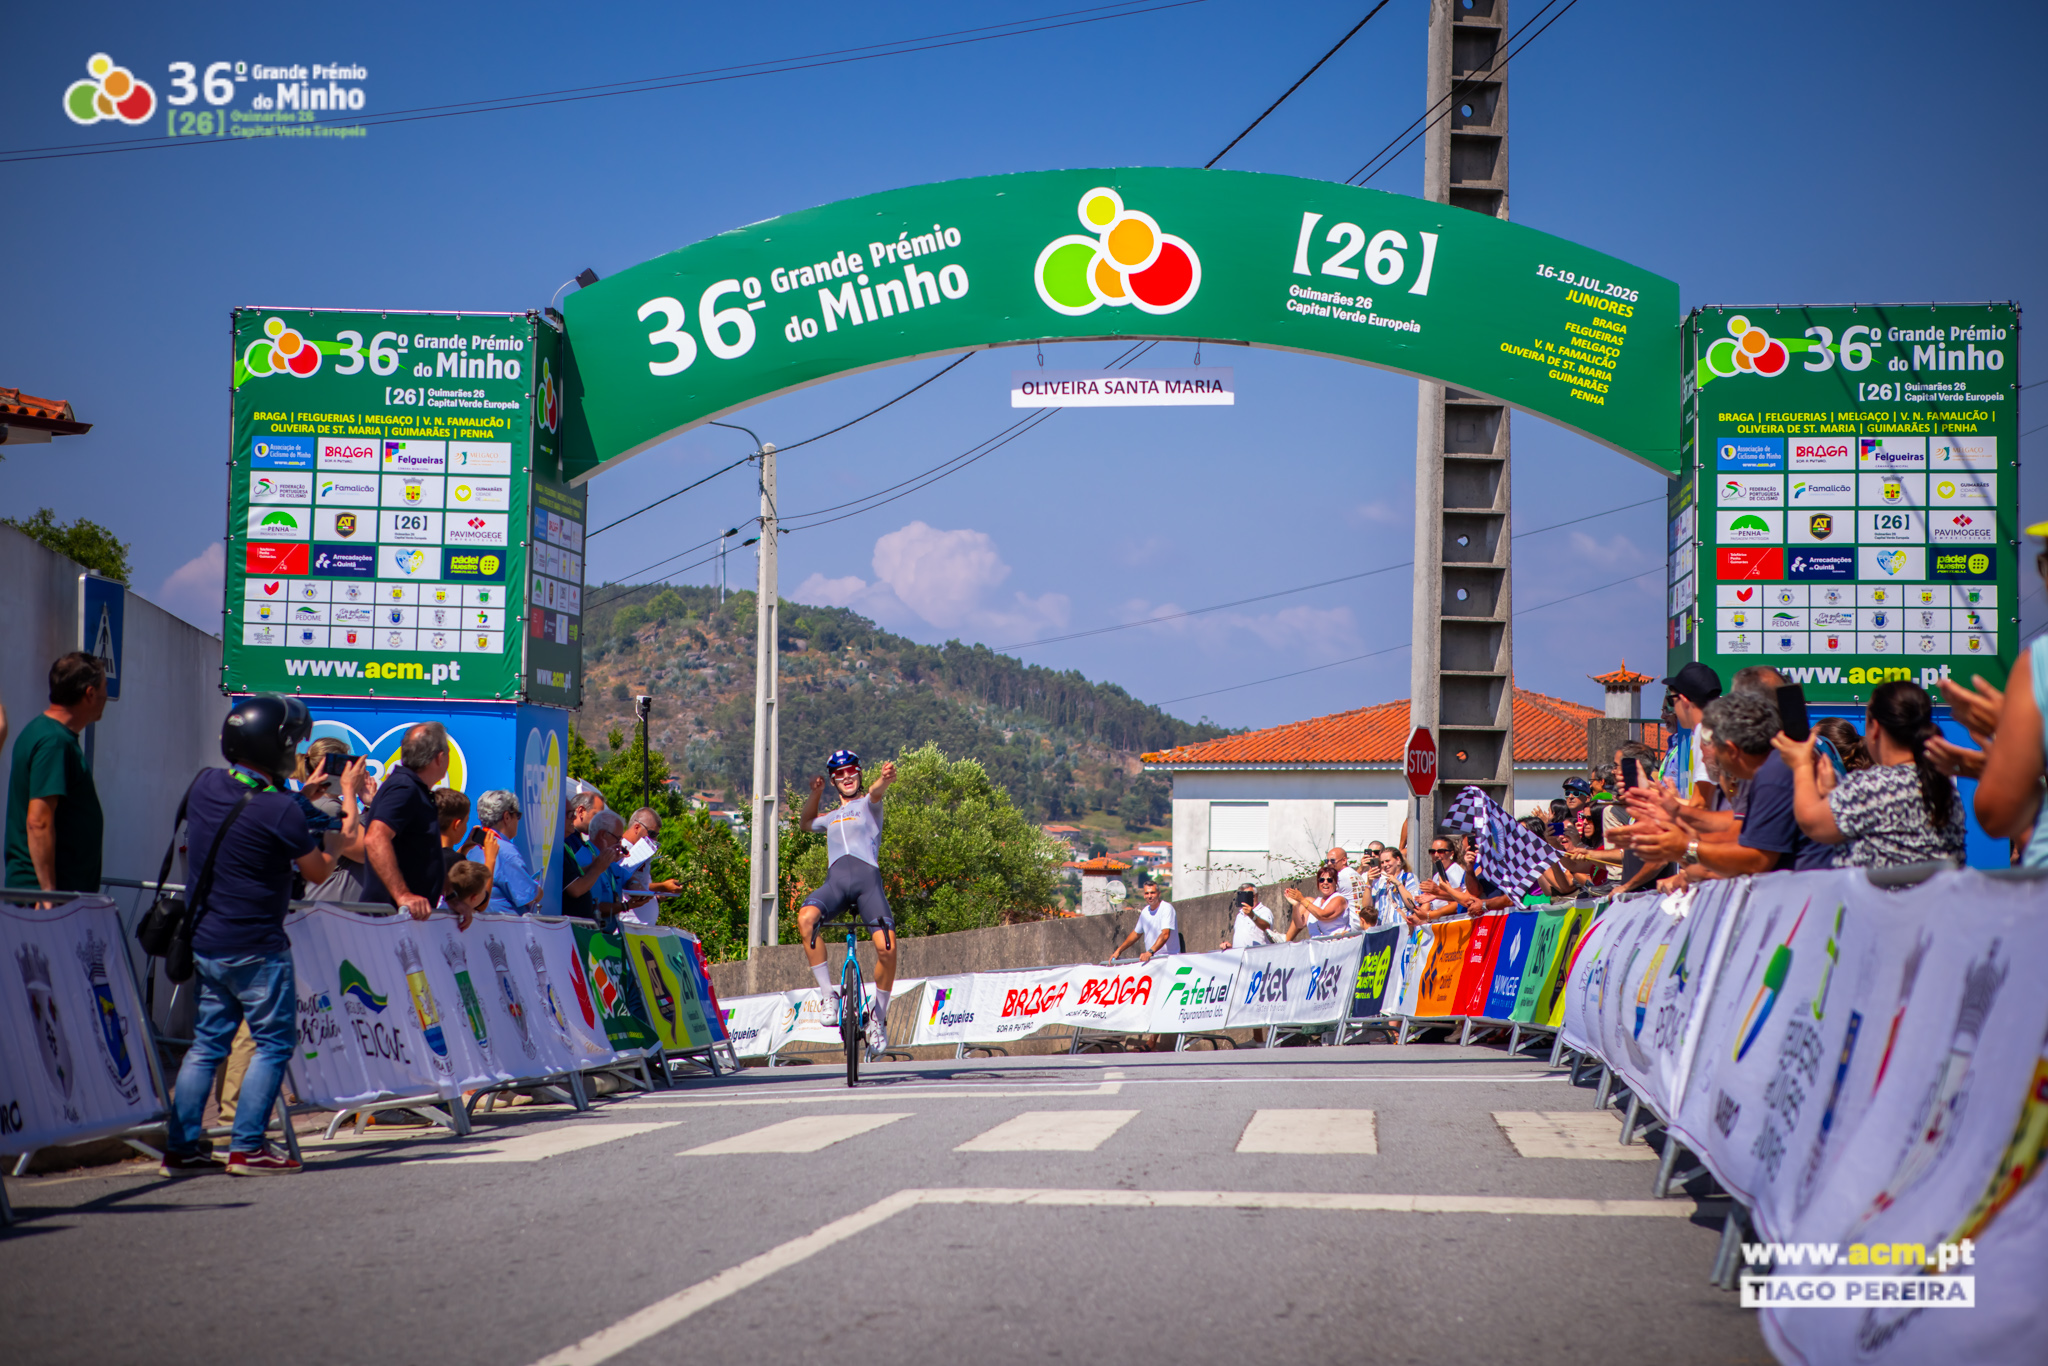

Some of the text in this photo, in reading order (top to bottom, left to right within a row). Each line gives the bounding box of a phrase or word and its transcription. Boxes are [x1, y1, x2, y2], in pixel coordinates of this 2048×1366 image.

[1536, 264, 1639, 303] 16-19.JUL.2026
[637, 224, 962, 377] 36º Grande Prémio
[784, 263, 969, 342] do Minho
[1289, 284, 1373, 309] Guimarães 26
[1566, 289, 1634, 318] JUNIORES
[1286, 299, 1421, 334] Capital Verde Europeia
[1592, 317, 1627, 334] BRAGA
[1565, 322, 1624, 346] FELGUEIRAS
[335, 331, 524, 376] 36º Grande Prémio
[1534, 339, 1616, 370] V. N. FAMALICÃO
[1571, 337, 1620, 358] MELGAÇO
[1803, 325, 2006, 372] 36º Grande Prémio
[1889, 343, 2004, 371] do Minho
[413, 351, 520, 379] do Minho
[1500, 343, 1612, 382] OLIVEIRA DE ST. MARIA
[1021, 379, 1223, 396] OLIVEIRA SANTA MARIA
[1549, 369, 1609, 394] GUIMARÃES
[1905, 383, 1952, 392] Guimarães
[1953, 383, 1966, 391] 26
[428, 388, 472, 398] Guimarães
[473, 390, 485, 398] 26
[1570, 389, 1604, 406] PENHA
[1905, 392, 2004, 403] Capital Verde Europeia
[427, 398, 519, 410] Capital Verde Europeia
[253, 412, 504, 428] BRAGA FELGUERIAS MELGAÇO V. N. FAMALICÃO
[1718, 410, 1988, 423] BRAGA FELGUERIAS MELGAÇO V. N. FAMALICÃO
[270, 424, 493, 438] OLIVEIRA DE ST. MARIA GUIMARÃES PENHA
[1737, 422, 1977, 434] OLIVEIRA DE ST. MARIA GUIMARÃES PENHA
[325, 446, 372, 458] BRAGA
[398, 456, 443, 465] Felgueiras
[1796, 445, 1847, 458] BRAGA
[1875, 453, 1924, 462] Felgueiras
[335, 484, 374, 492] Famalicão
[1938, 555, 1966, 564] pádel
[285, 659, 460, 685] www.acm.pt
[1408, 750, 1435, 774] STOP
[1001, 982, 1068, 1017] BRAGA
[1077, 974, 1152, 1009] BRAGA
[939, 1010, 974, 1026] Felgueiras
